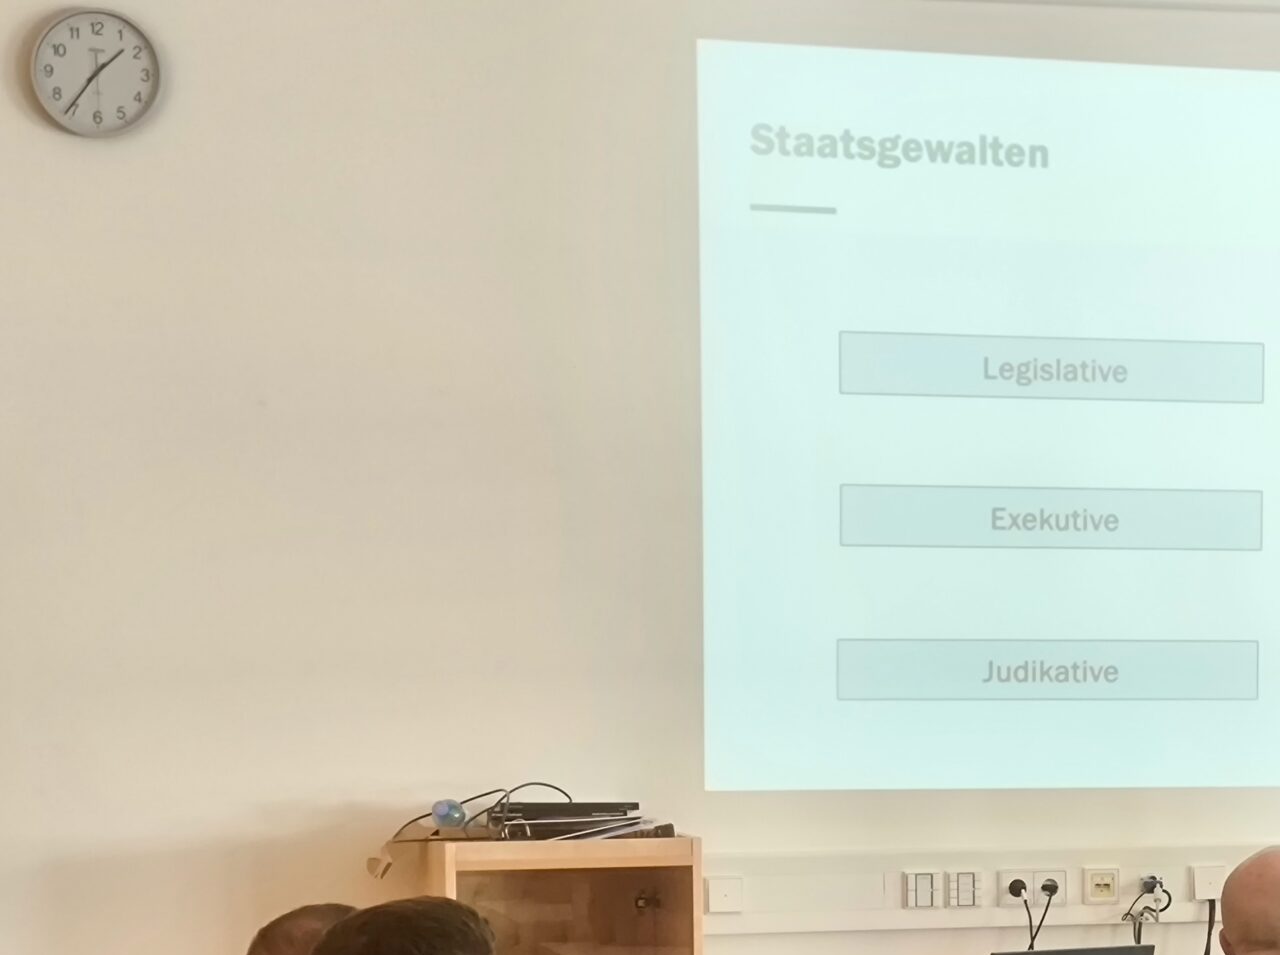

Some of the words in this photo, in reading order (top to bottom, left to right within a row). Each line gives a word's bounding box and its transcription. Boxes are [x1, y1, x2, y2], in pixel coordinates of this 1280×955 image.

[69, 26, 81, 40] 11
[89, 21, 105, 36] 12
[117, 28, 124, 42] 1
[52, 43, 67, 58] 10
[132, 46, 142, 59] 2
[43, 64, 54, 78] 9
[140, 68, 150, 83] 3
[52, 86, 62, 101] 8
[133, 91, 142, 104] 4
[70, 103, 80, 118] 7
[92, 110, 103, 125] 6
[116, 106, 126, 120] 5
[749, 122, 1050, 170] Staatsgewalten
[982, 356, 1128, 387] Legislative
[991, 506, 1120, 533] Exekutive
[982, 660, 1120, 684] Judikative
